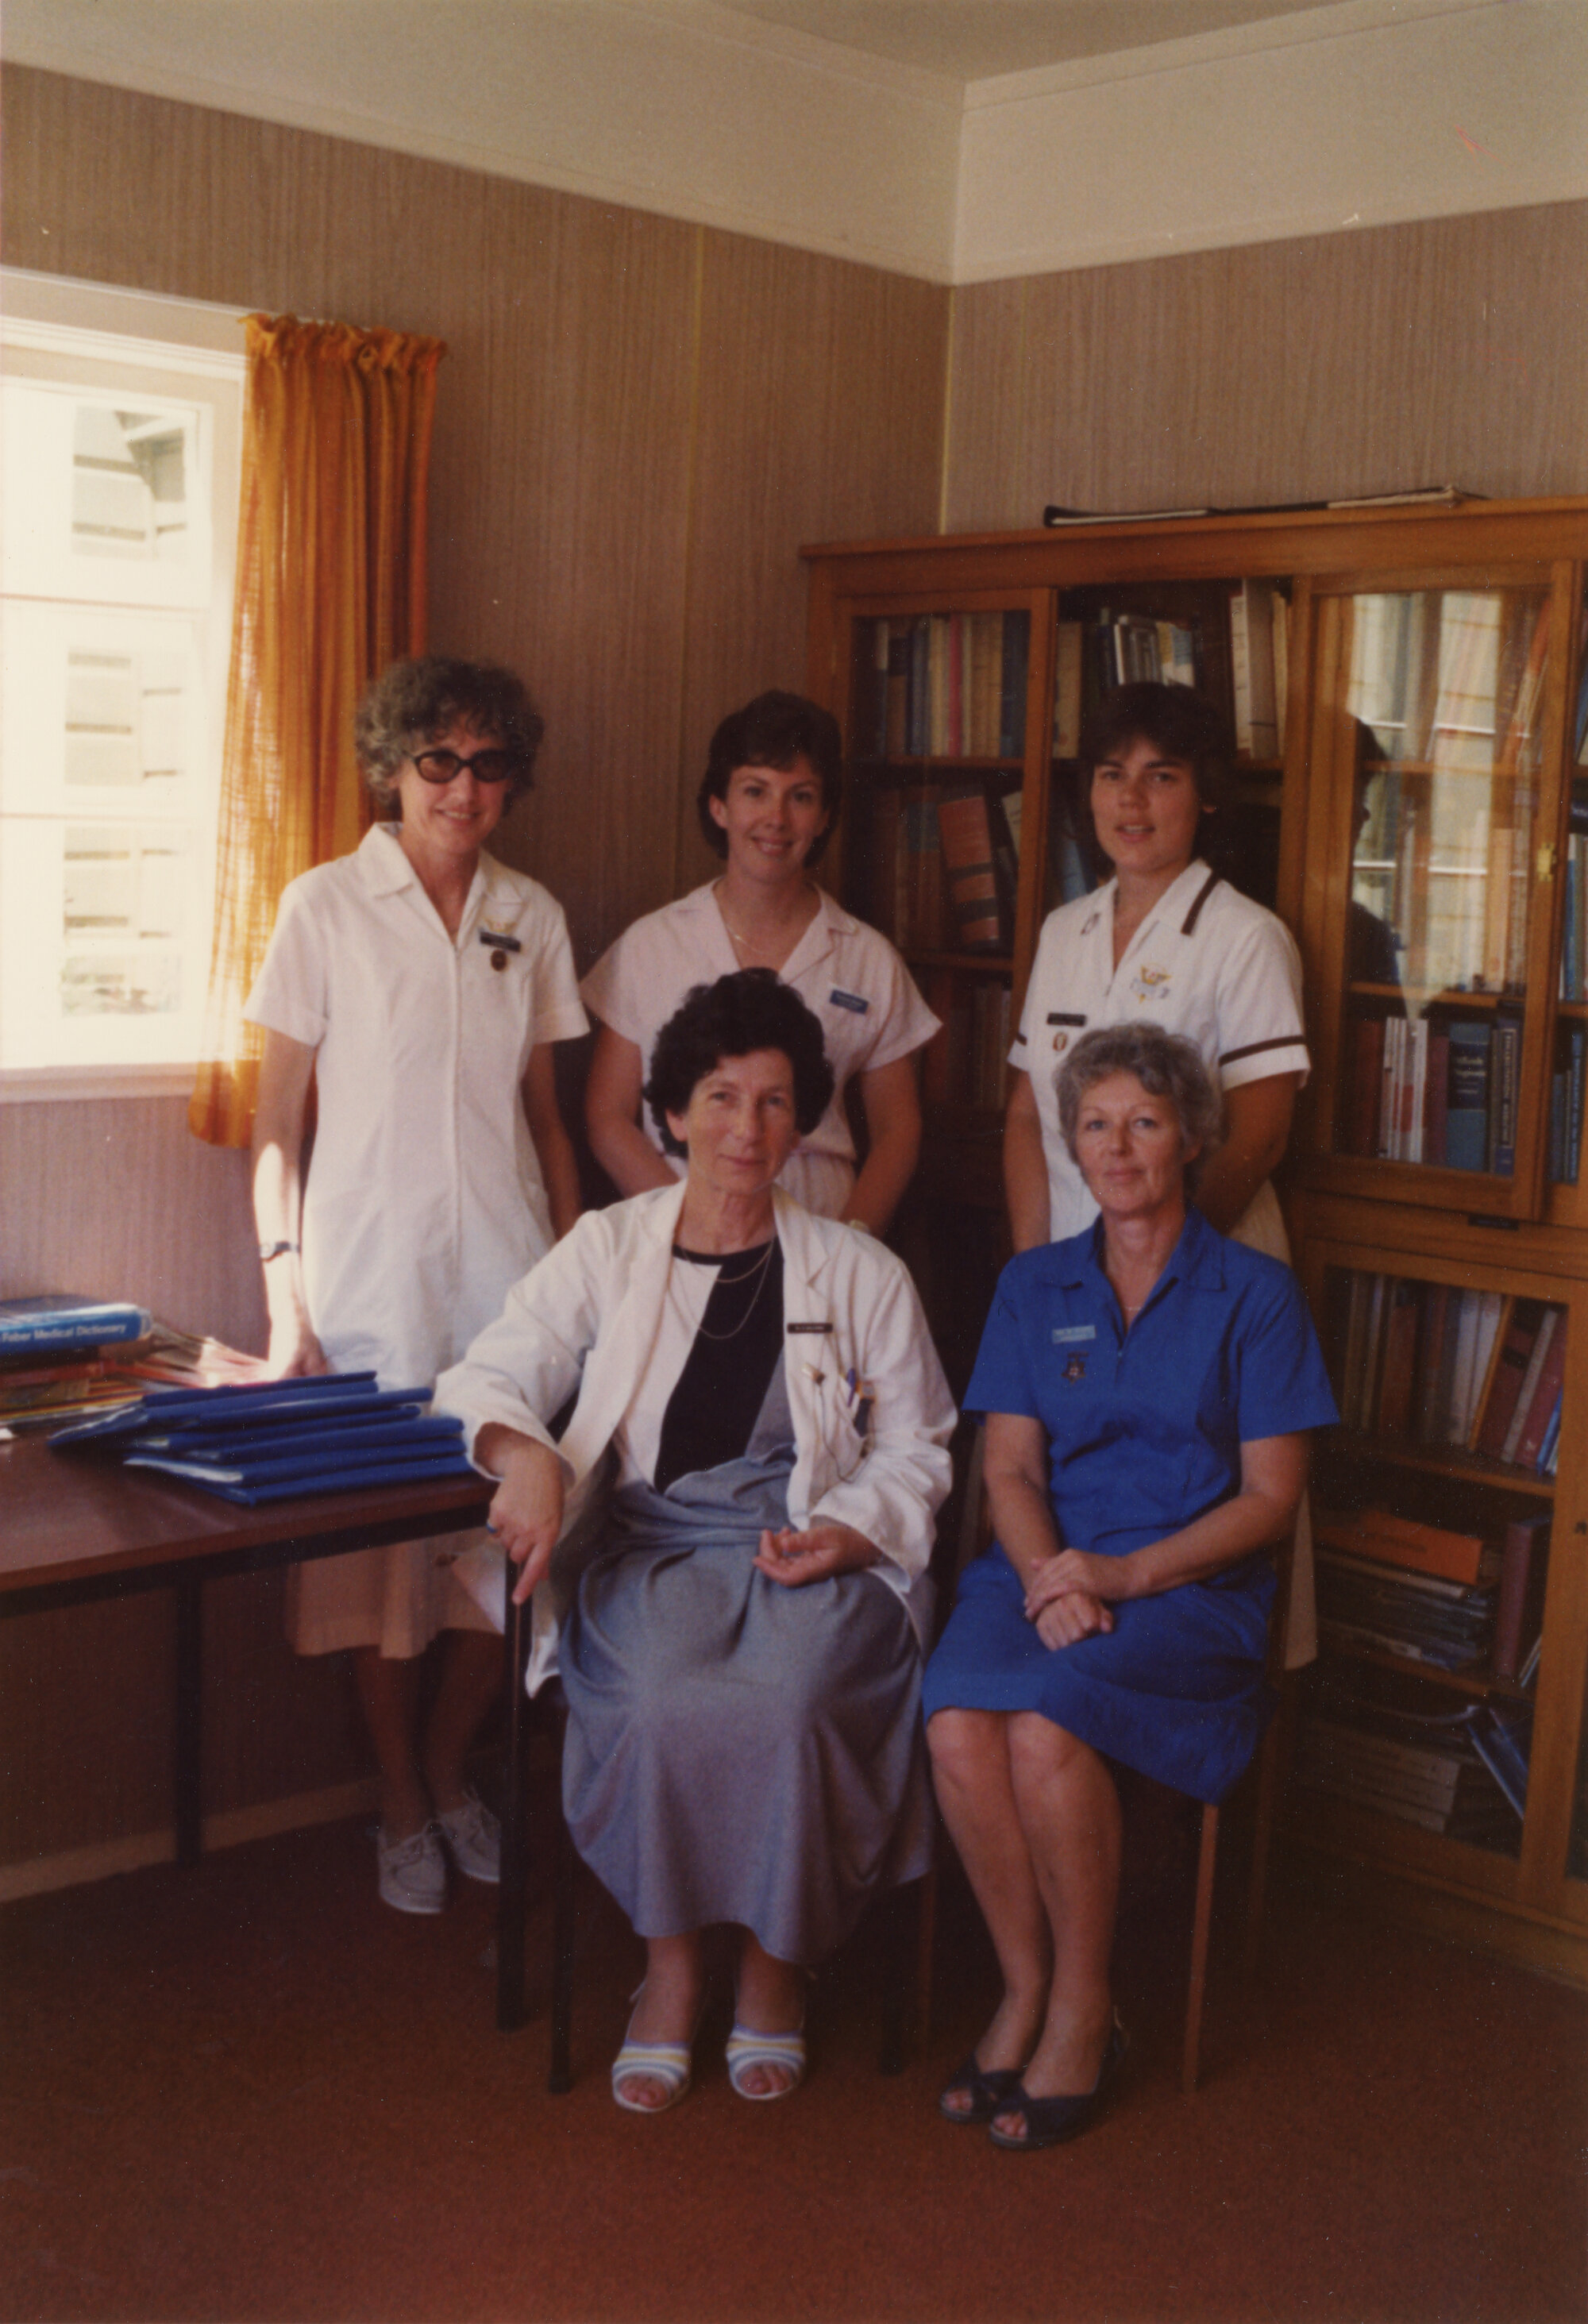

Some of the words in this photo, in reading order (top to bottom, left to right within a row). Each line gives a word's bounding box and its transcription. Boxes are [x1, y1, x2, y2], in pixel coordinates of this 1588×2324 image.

[2, 1332, 31, 1343] Faber
[33, 1328, 74, 1340] Medical
[76, 1324, 127, 1335] Dictionary
